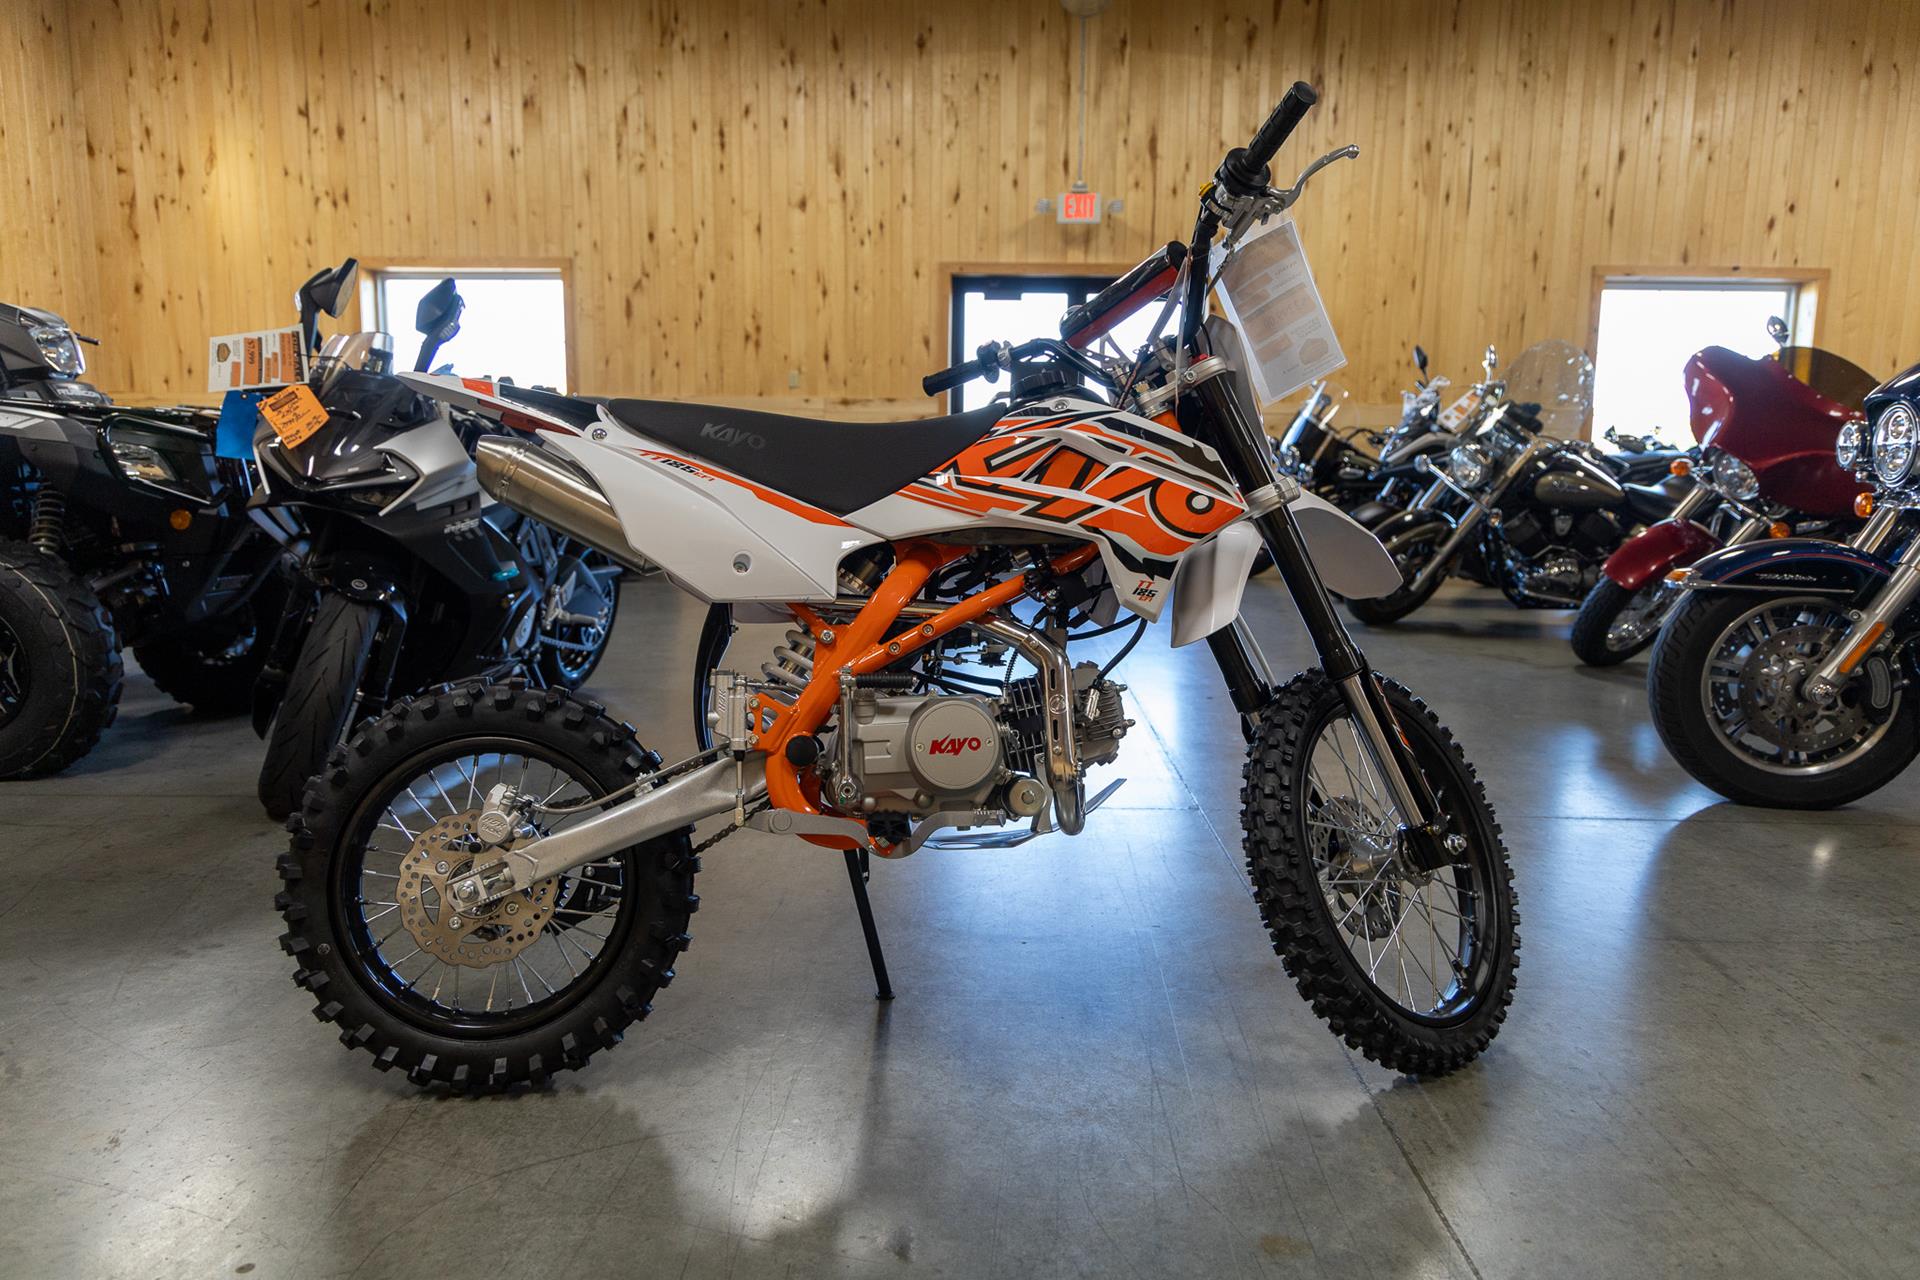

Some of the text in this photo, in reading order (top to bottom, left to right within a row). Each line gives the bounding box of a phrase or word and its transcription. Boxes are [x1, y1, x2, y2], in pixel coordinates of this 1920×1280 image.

[1064, 193, 1096, 219] EXIT
[700, 422, 767, 449] KAYO
[929, 733, 982, 756] KAYO
